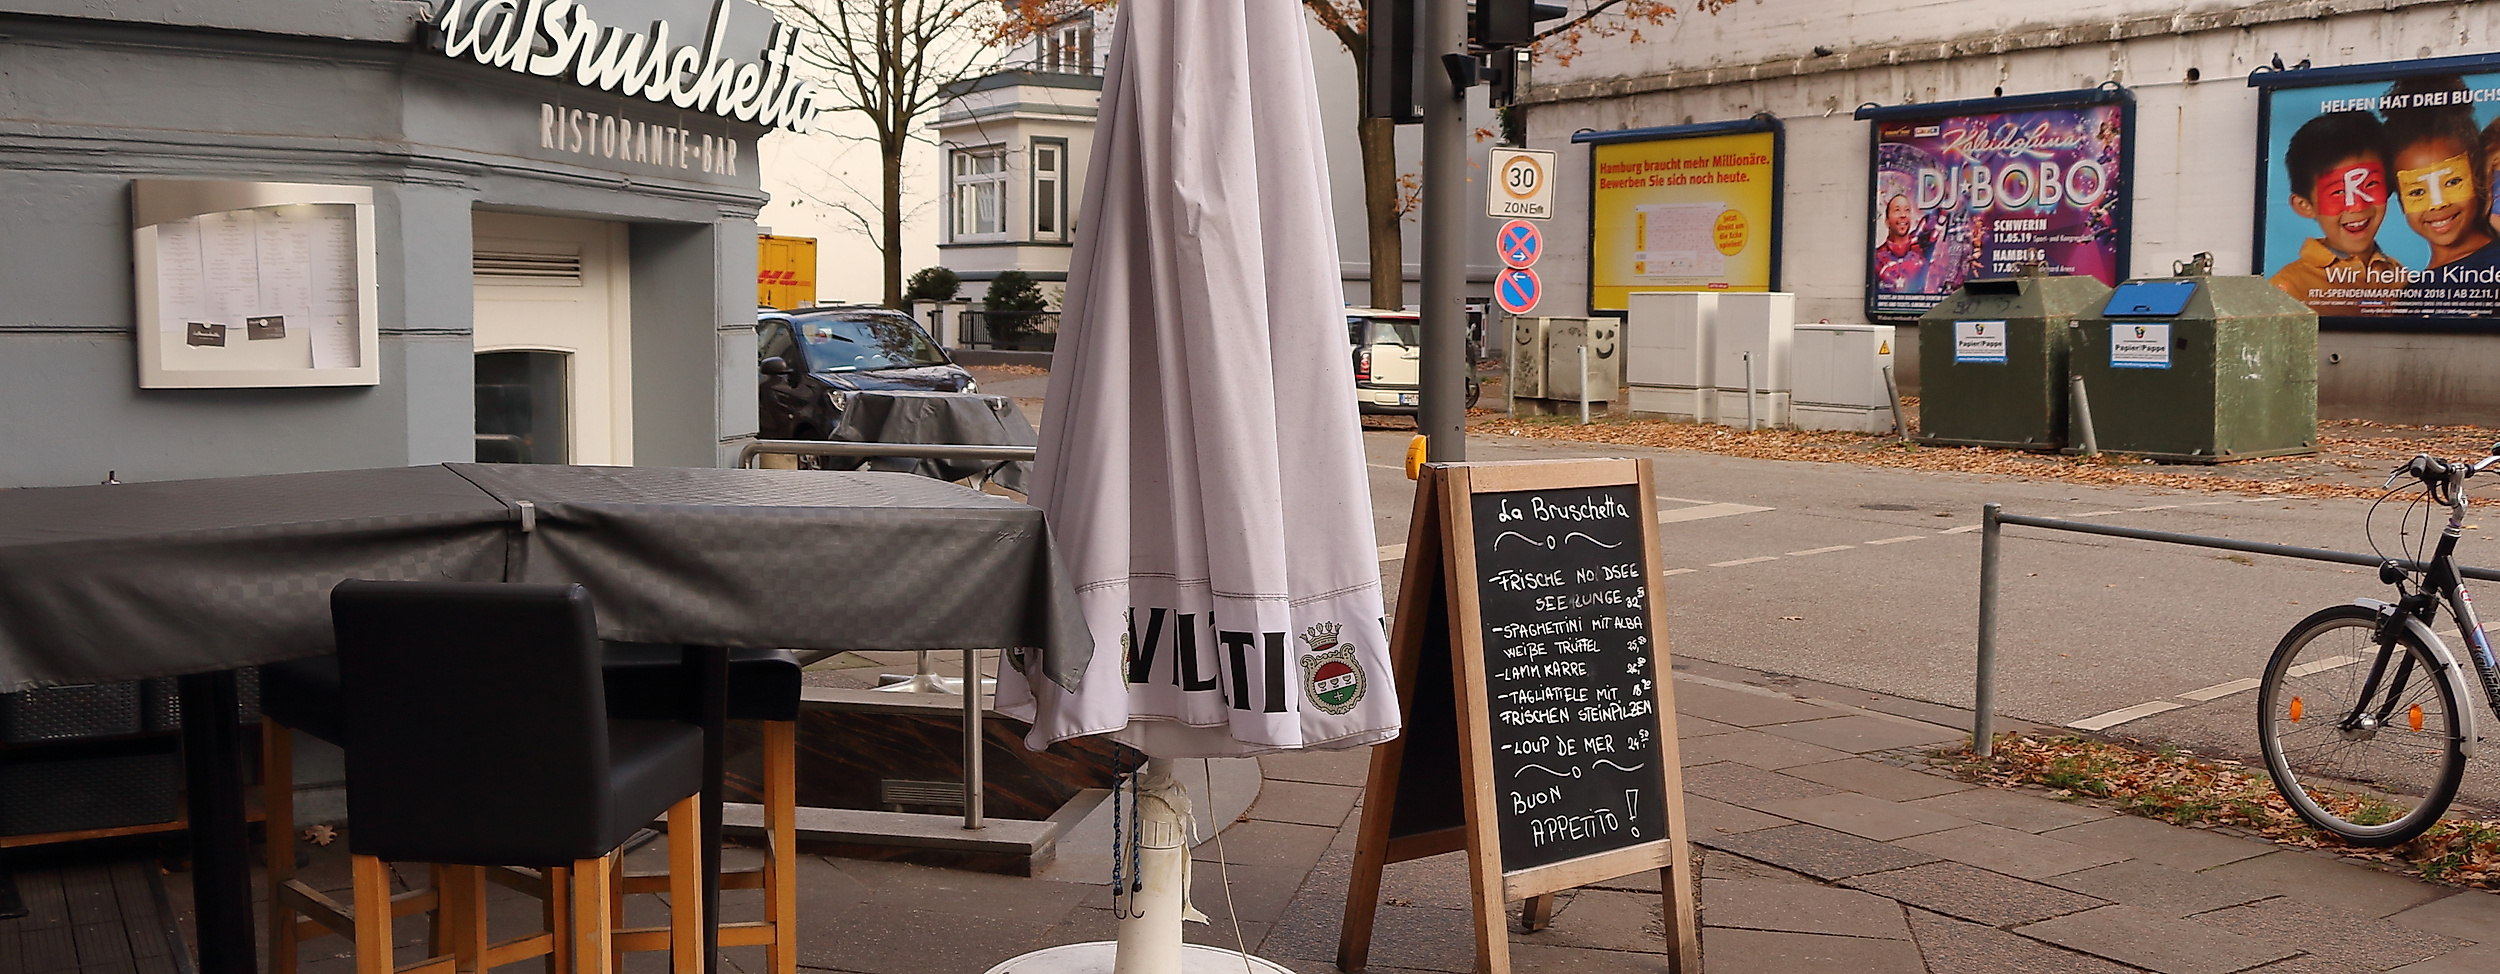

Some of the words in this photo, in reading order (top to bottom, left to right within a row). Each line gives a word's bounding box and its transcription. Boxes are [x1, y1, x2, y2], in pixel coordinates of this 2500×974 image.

[2320, 97, 2376, 114] HELFEN
[2379, 94, 2410, 110] HAT
[2412, 91, 2449, 108] DREI
[1600, 162, 1642, 175] Hamburg
[1644, 158, 1681, 172] braucht
[1683, 156, 1709, 169] mehr
[1712, 152, 1770, 167] Millionäre.
[1509, 167, 1535, 188] 30
[1600, 176, 1646, 190] Bewerben
[1649, 175, 1664, 187] Sie
[1667, 173, 1686, 186] sich
[1689, 172, 1714, 185] noch
[1716, 171, 1750, 184] heute.
[1917, 165, 1959, 210] DJ
[1971, 159, 2107, 209] BOBO
[2344, 167, 2374, 207] R
[2418, 167, 2452, 206] T
[1504, 201, 1537, 214] ZONE
[1993, 218, 2048, 232] SCHWERIN
[2324, 266, 2361, 284] Wir
[2366, 266, 2435, 284] helfen
[2453, 289, 2468, 299] AB
[1498, 498, 1523, 523] La
[1531, 494, 1630, 522] Bruschetta
[1614, 615, 1643, 631] ALBA
[1543, 660, 1588, 677] KARRE
[1596, 684, 1619, 701] MIT
[1499, 706, 1570, 726] FRISCHEN
[1578, 699, 1653, 723] STEINPILZEN
[1555, 735, 1578, 756] DE
[1584, 734, 1616, 755] MER
[1510, 785, 1562, 816] BUON
[1530, 808, 1619, 848] APPETITO
